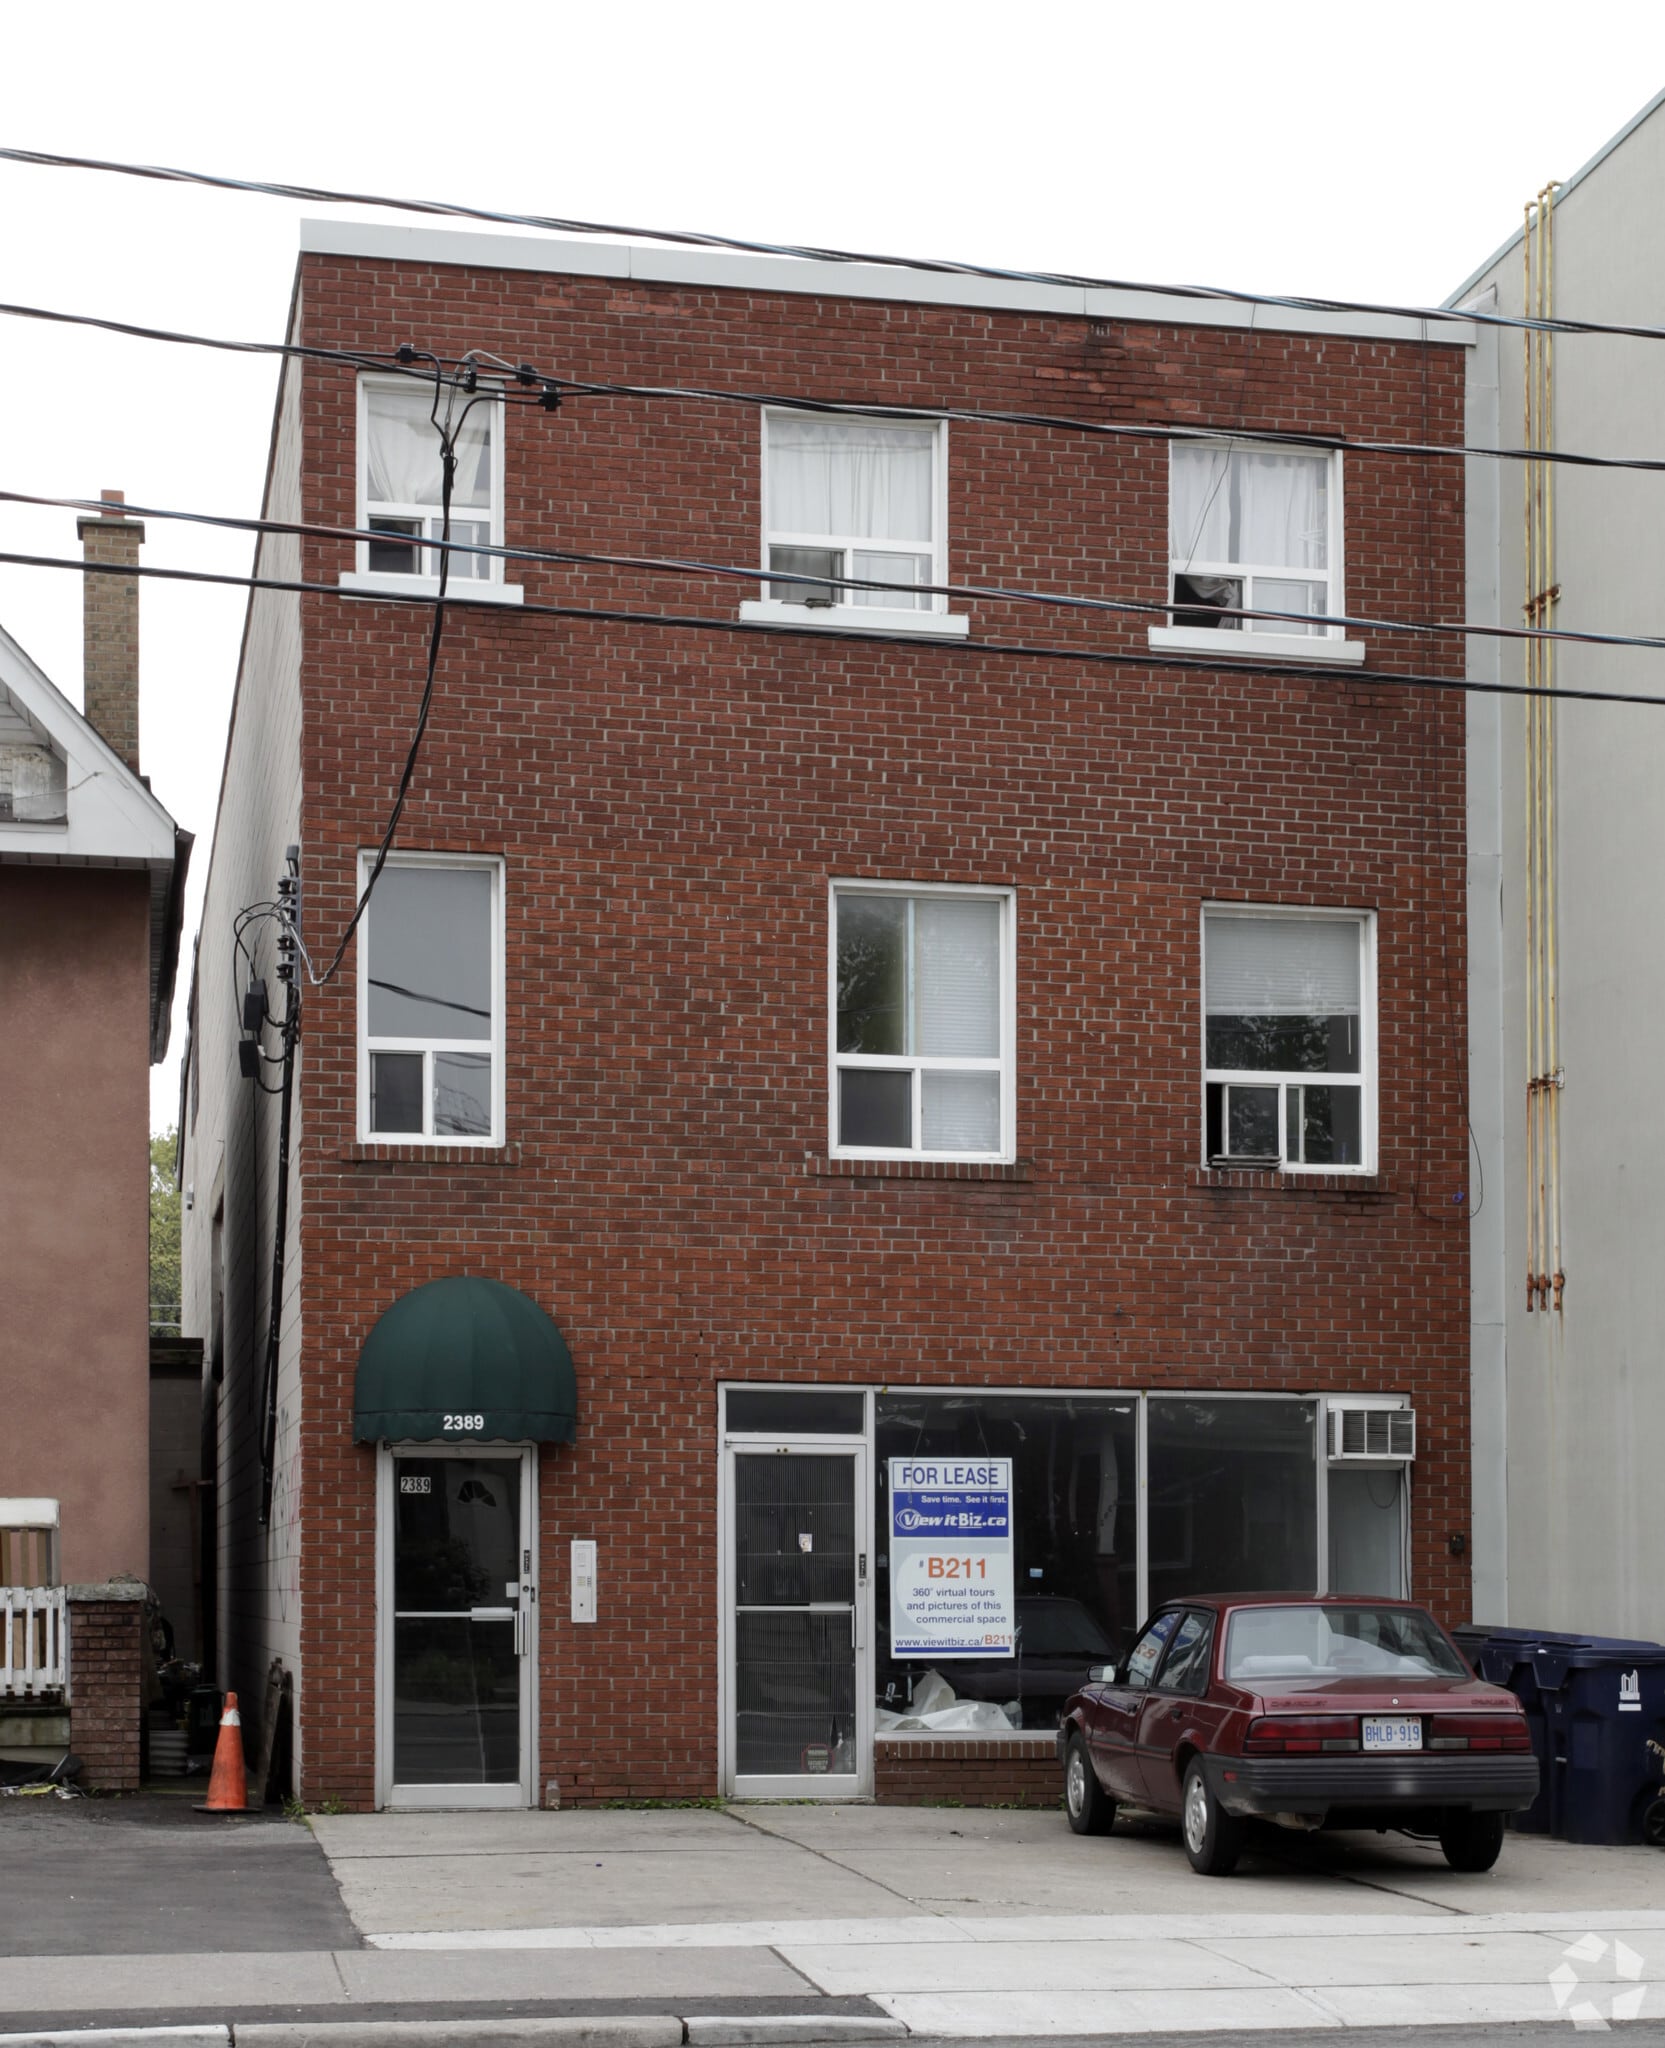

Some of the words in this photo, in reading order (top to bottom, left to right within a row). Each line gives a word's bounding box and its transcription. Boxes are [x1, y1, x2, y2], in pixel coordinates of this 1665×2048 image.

[443, 1415, 484, 1430] 2389
[902, 1467, 938, 1485] FOR
[944, 1467, 999, 1485] LEASE
[402, 1479, 430, 1492] 2389
[936, 1588, 967, 1597] virtual
[969, 1588, 995, 1597] tours
[906, 1602, 925, 1610] and
[928, 1601, 968, 1612] pictures
[970, 1601, 981, 1610] of
[983, 1601, 1001, 1610] this
[916, 1615, 974, 1624] commercial
[977, 1616, 1007, 1625] space
[1365, 1725, 1393, 1741] BHLB
[1400, 1725, 1420, 1741] 919
